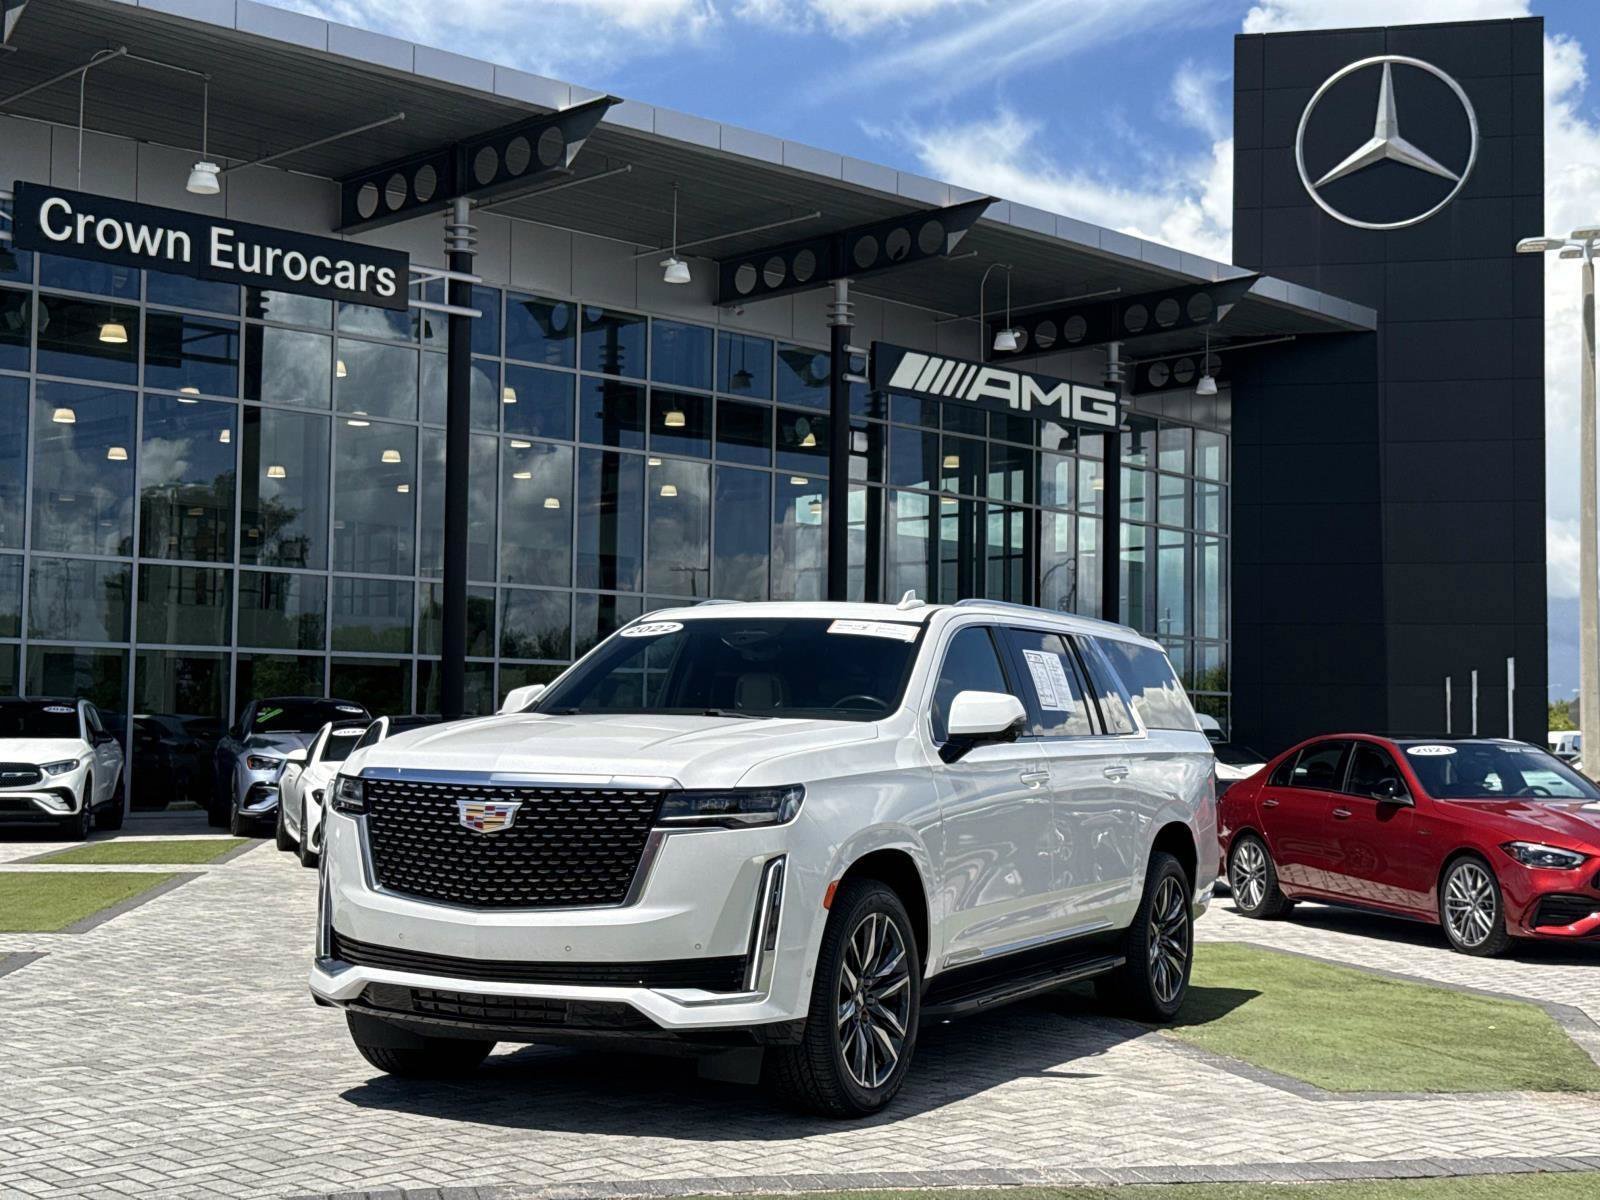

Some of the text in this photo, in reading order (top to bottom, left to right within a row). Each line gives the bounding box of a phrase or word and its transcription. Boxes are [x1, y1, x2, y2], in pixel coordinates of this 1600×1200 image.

[39, 197, 397, 297] Crown Eurocars
[966, 367, 1116, 427] AMG
[624, 623, 677, 635] 2022
